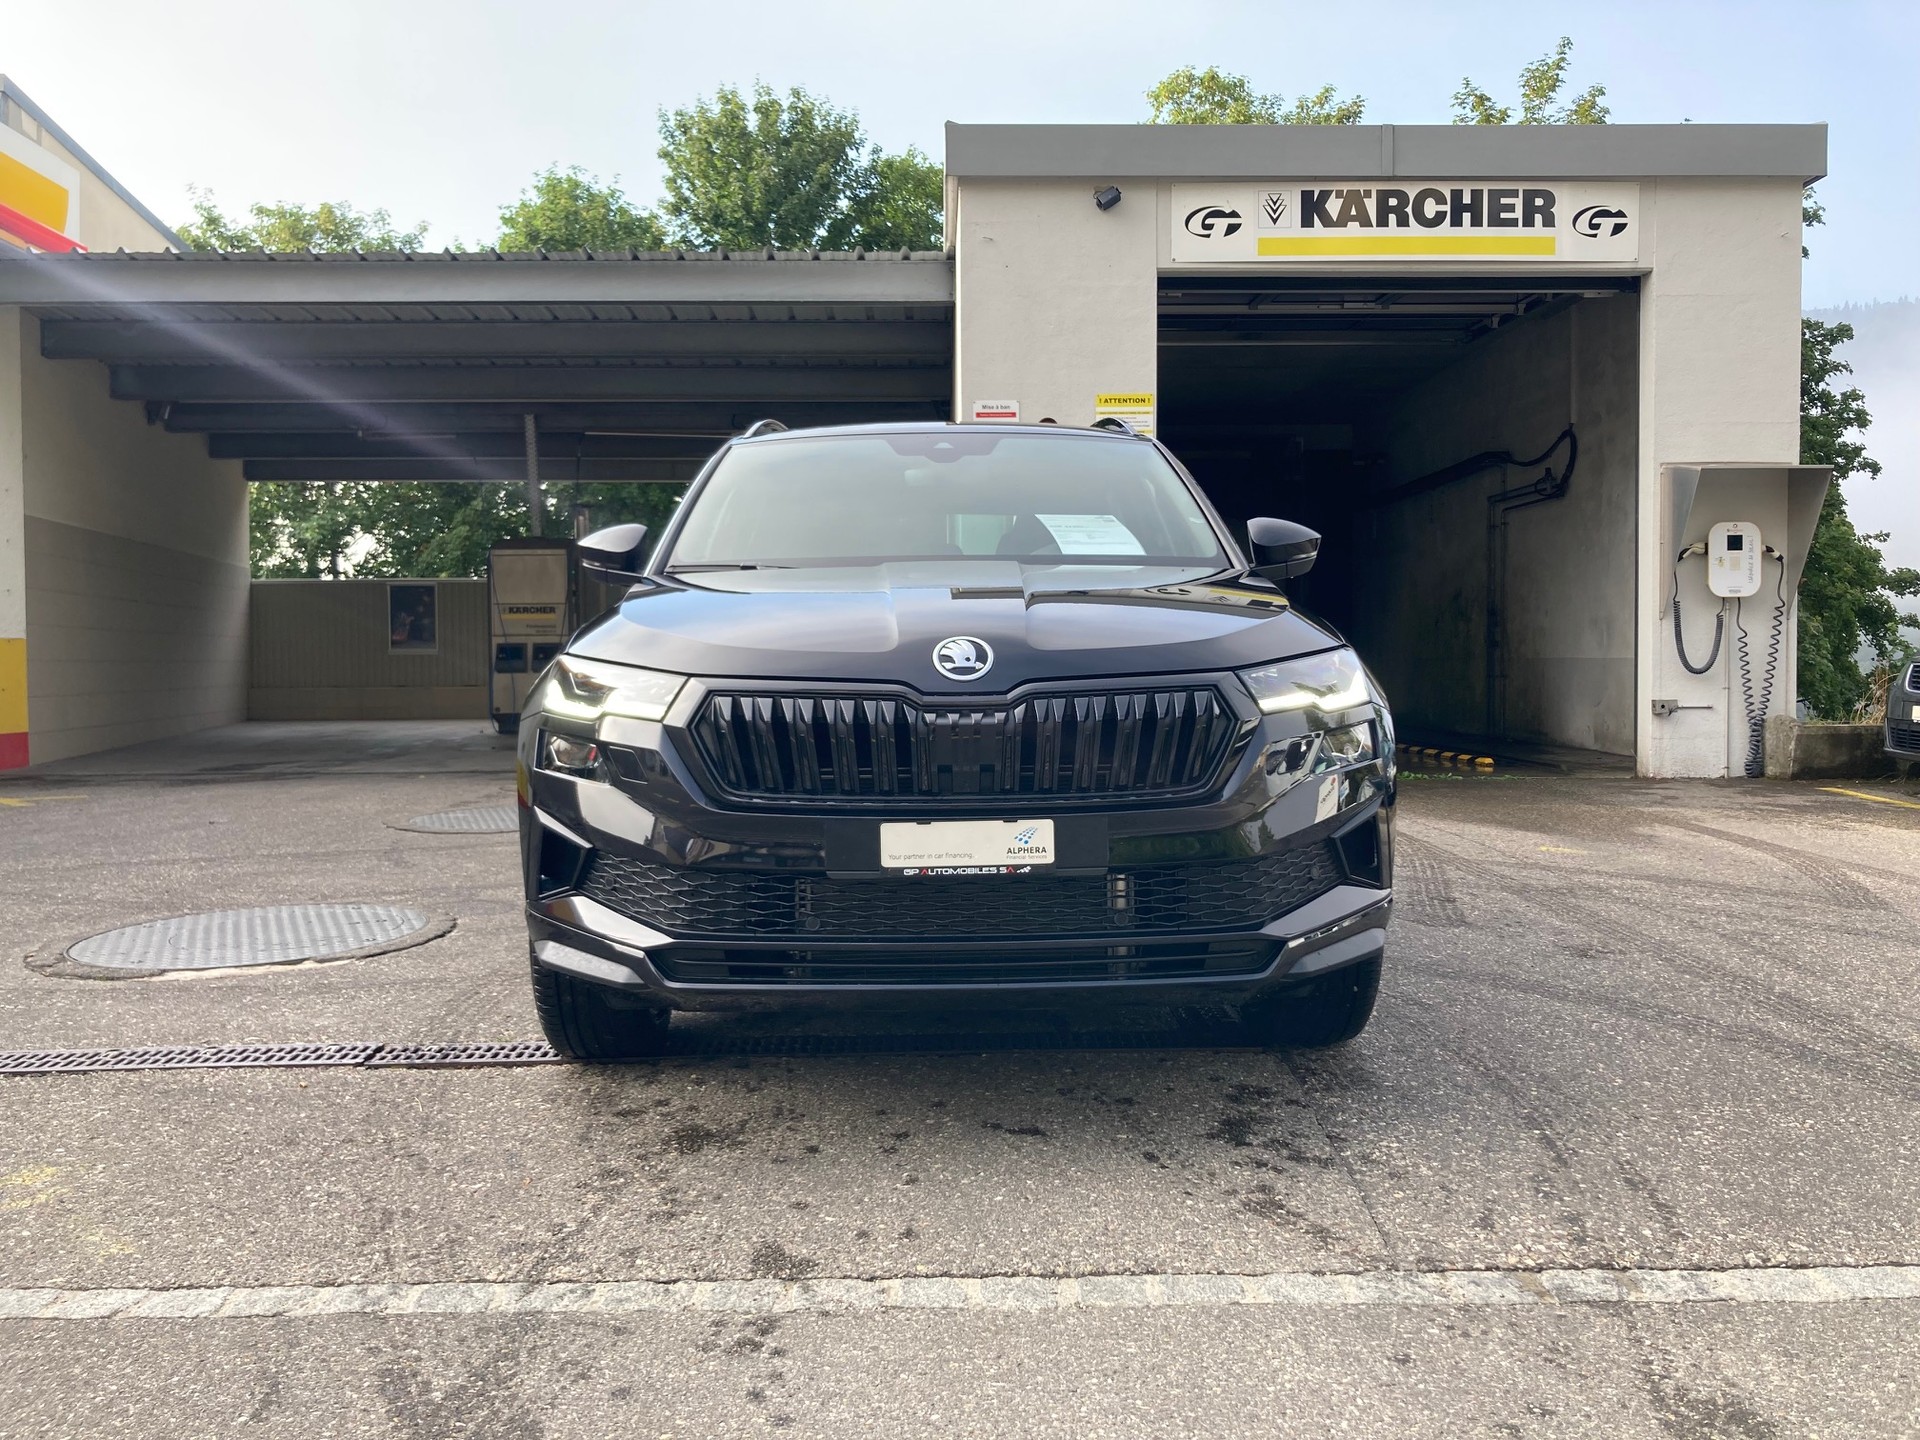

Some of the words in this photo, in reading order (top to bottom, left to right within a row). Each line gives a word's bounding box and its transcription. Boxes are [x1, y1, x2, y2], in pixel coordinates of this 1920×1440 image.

[1300, 187, 1557, 229] KÄRCHER
[1006, 846, 1047, 855] ALPHERA
[903, 853, 925, 861] partner
[903, 868, 920, 876] GP
[920, 866, 998, 876] AUTOMOBILES
[999, 865, 1015, 874] SA
